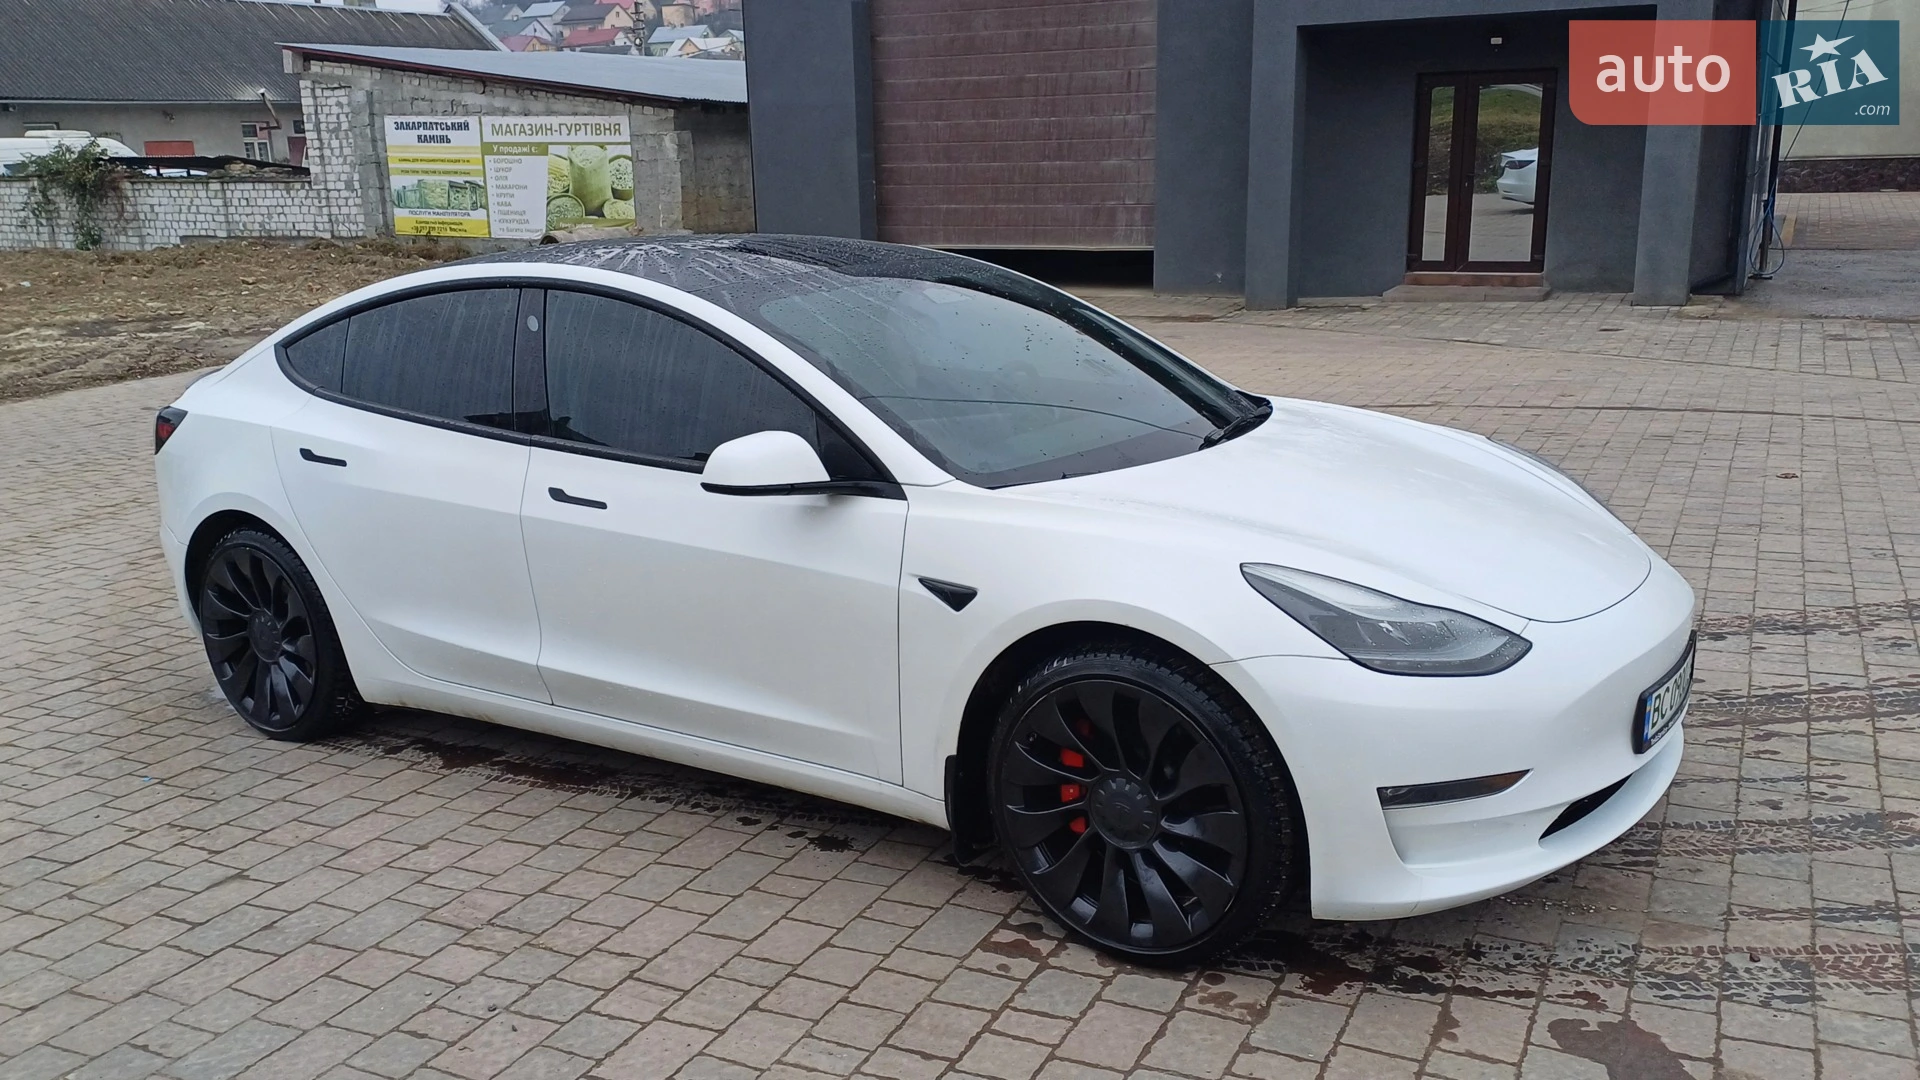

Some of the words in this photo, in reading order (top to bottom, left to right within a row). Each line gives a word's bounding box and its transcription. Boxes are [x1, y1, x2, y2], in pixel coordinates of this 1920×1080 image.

[393, 120, 470, 131] ЗАКАРПАТСЬКИЙ
[491, 123, 622, 136] МАГАЗИН-ГУРТІВНЯ
[416, 134, 452, 144] КАМІНЬ
[492, 145, 499, 153] У
[499, 144, 531, 154] продажі
